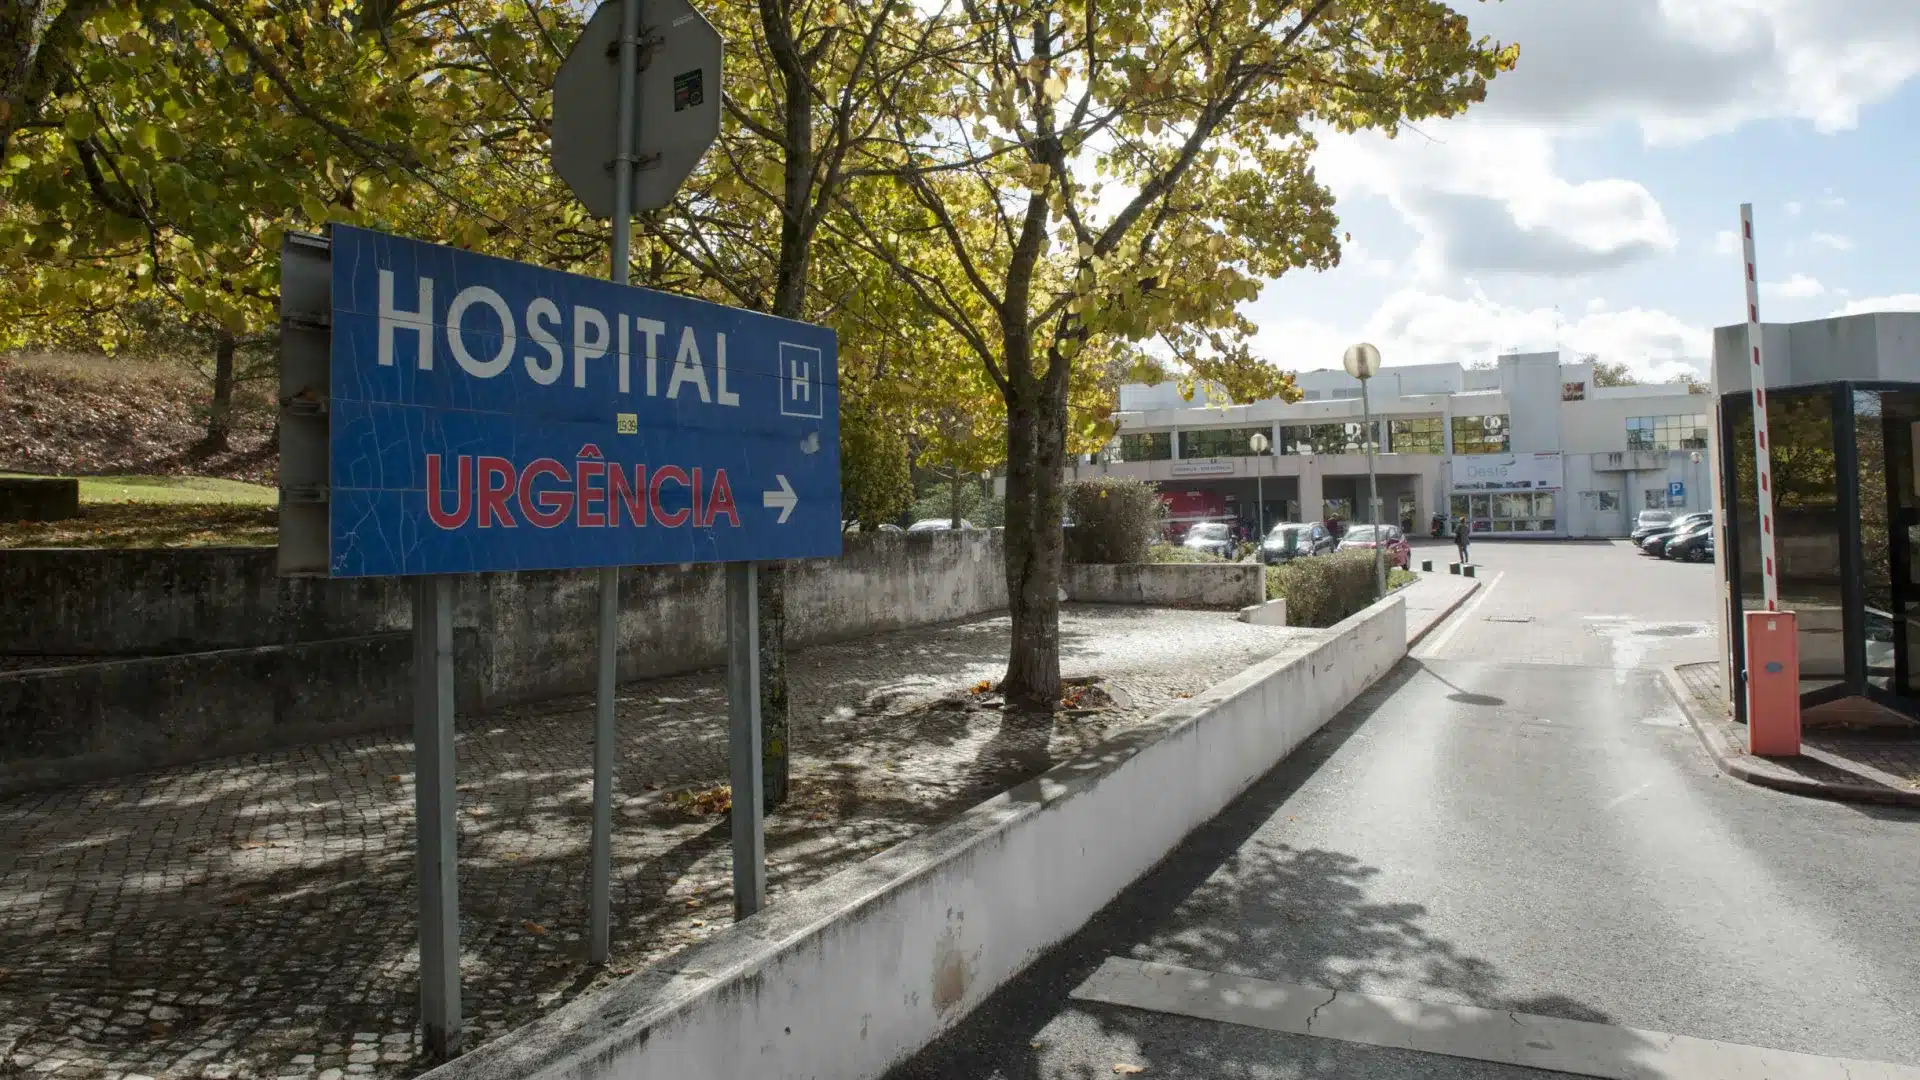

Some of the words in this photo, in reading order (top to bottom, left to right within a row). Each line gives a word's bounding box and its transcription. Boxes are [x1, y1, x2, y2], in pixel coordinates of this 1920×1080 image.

[378, 269, 740, 407] HOSPITAL
[790, 360, 810, 402] H
[426, 443, 740, 531] URGÊNCIA
[1671, 483, 1681, 496] P
